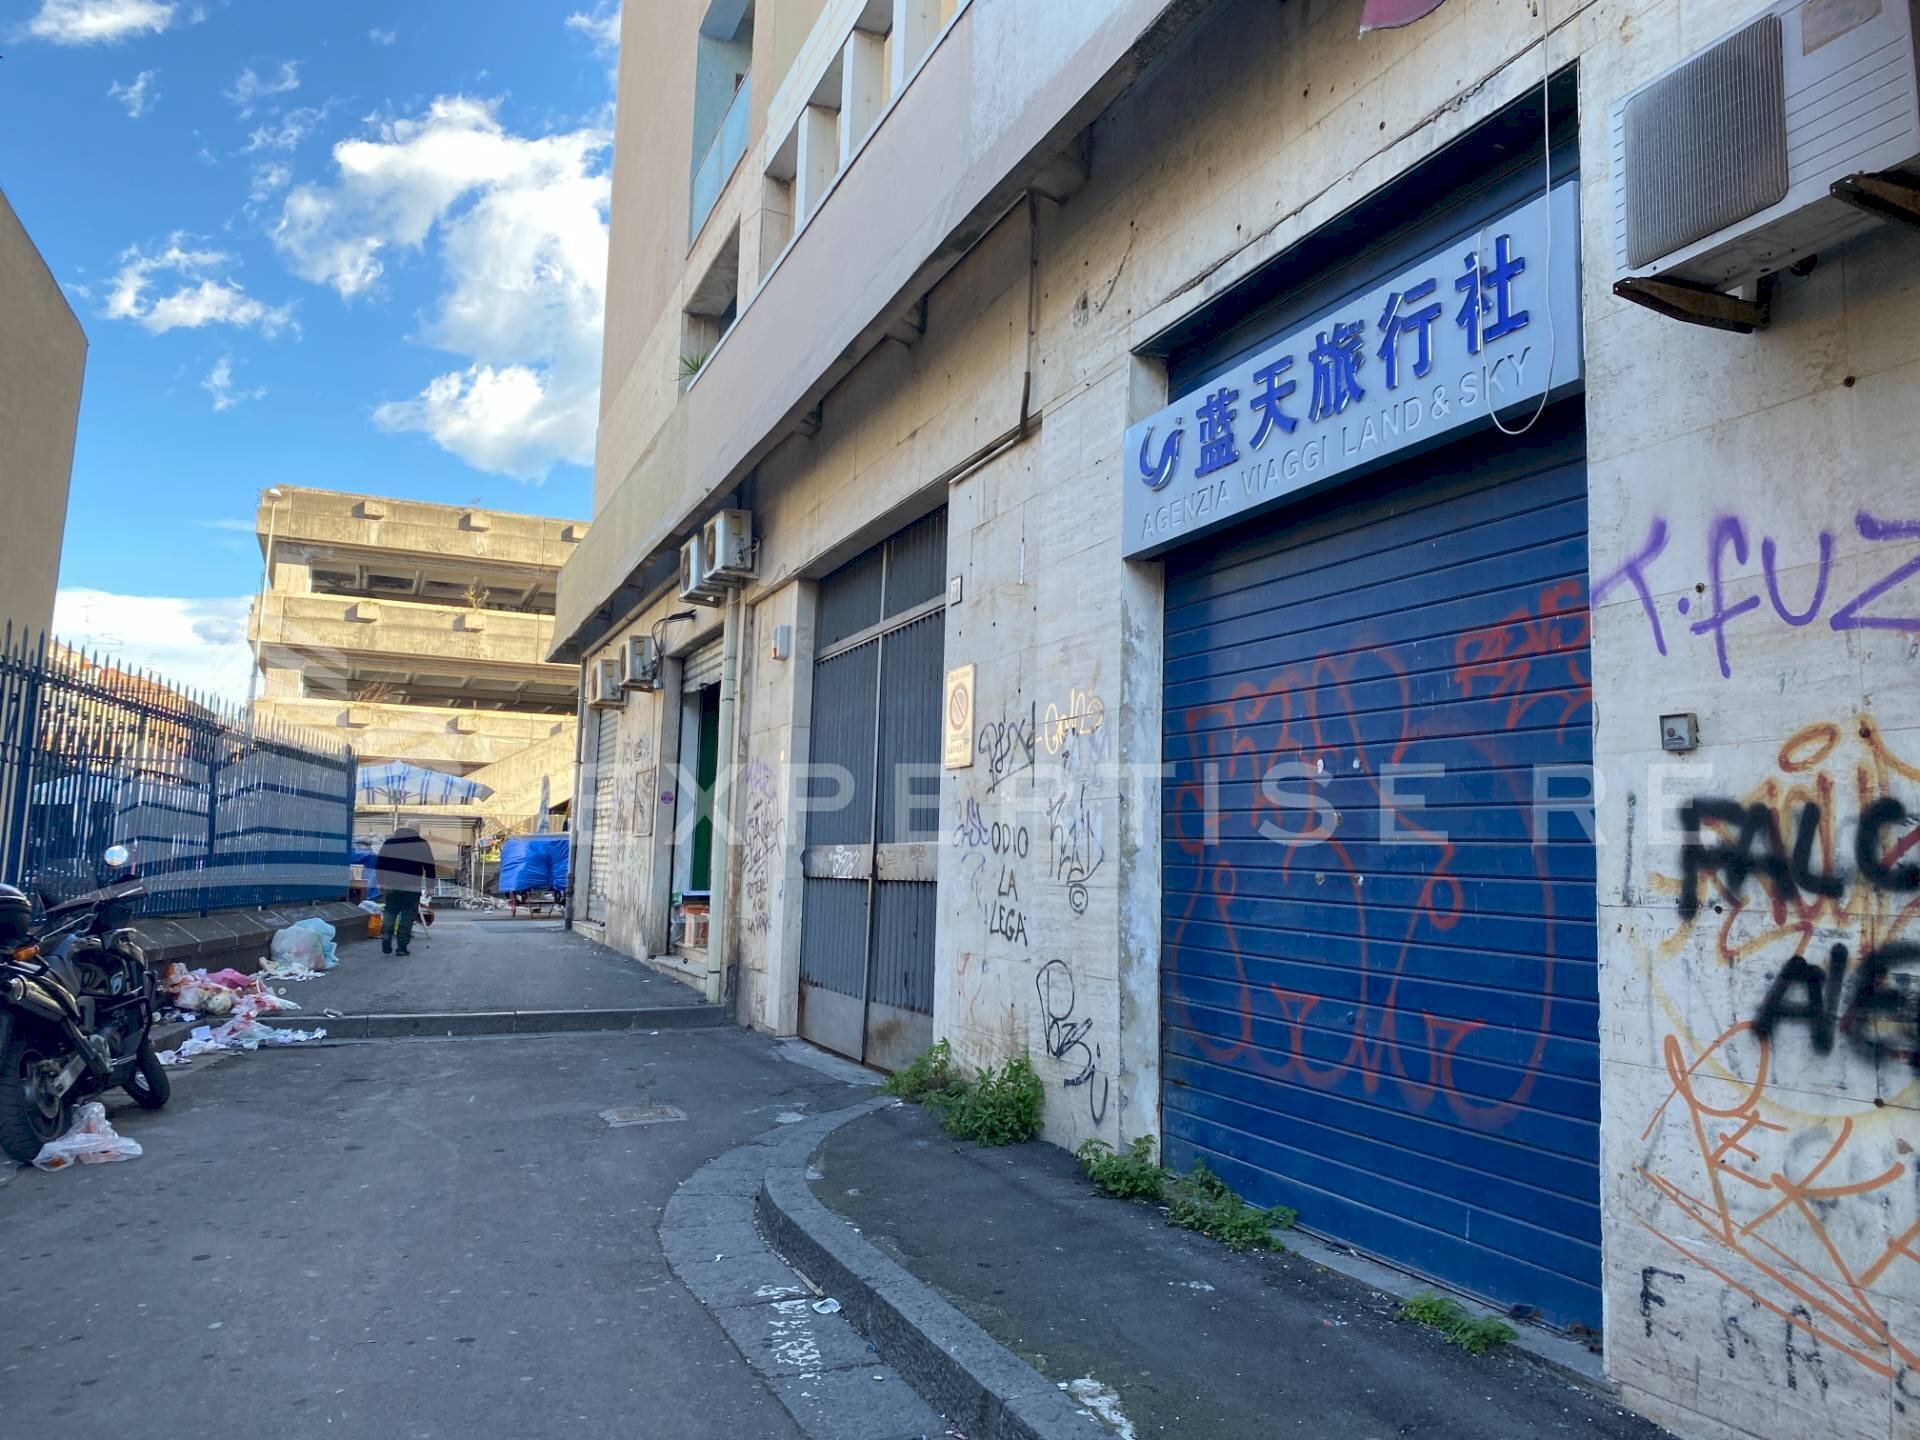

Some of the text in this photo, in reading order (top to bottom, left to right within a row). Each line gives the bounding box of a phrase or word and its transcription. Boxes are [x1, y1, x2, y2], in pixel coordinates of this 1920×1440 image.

[1195, 233, 1530, 479] 蓝天旅行社
[1141, 479, 1231, 541] AGENZIA
[1241, 434, 1327, 497] VIAGGI
[991, 821, 1029, 859] ODIO
[998, 864, 1018, 901] LA
[989, 900, 1029, 947] LEGA
